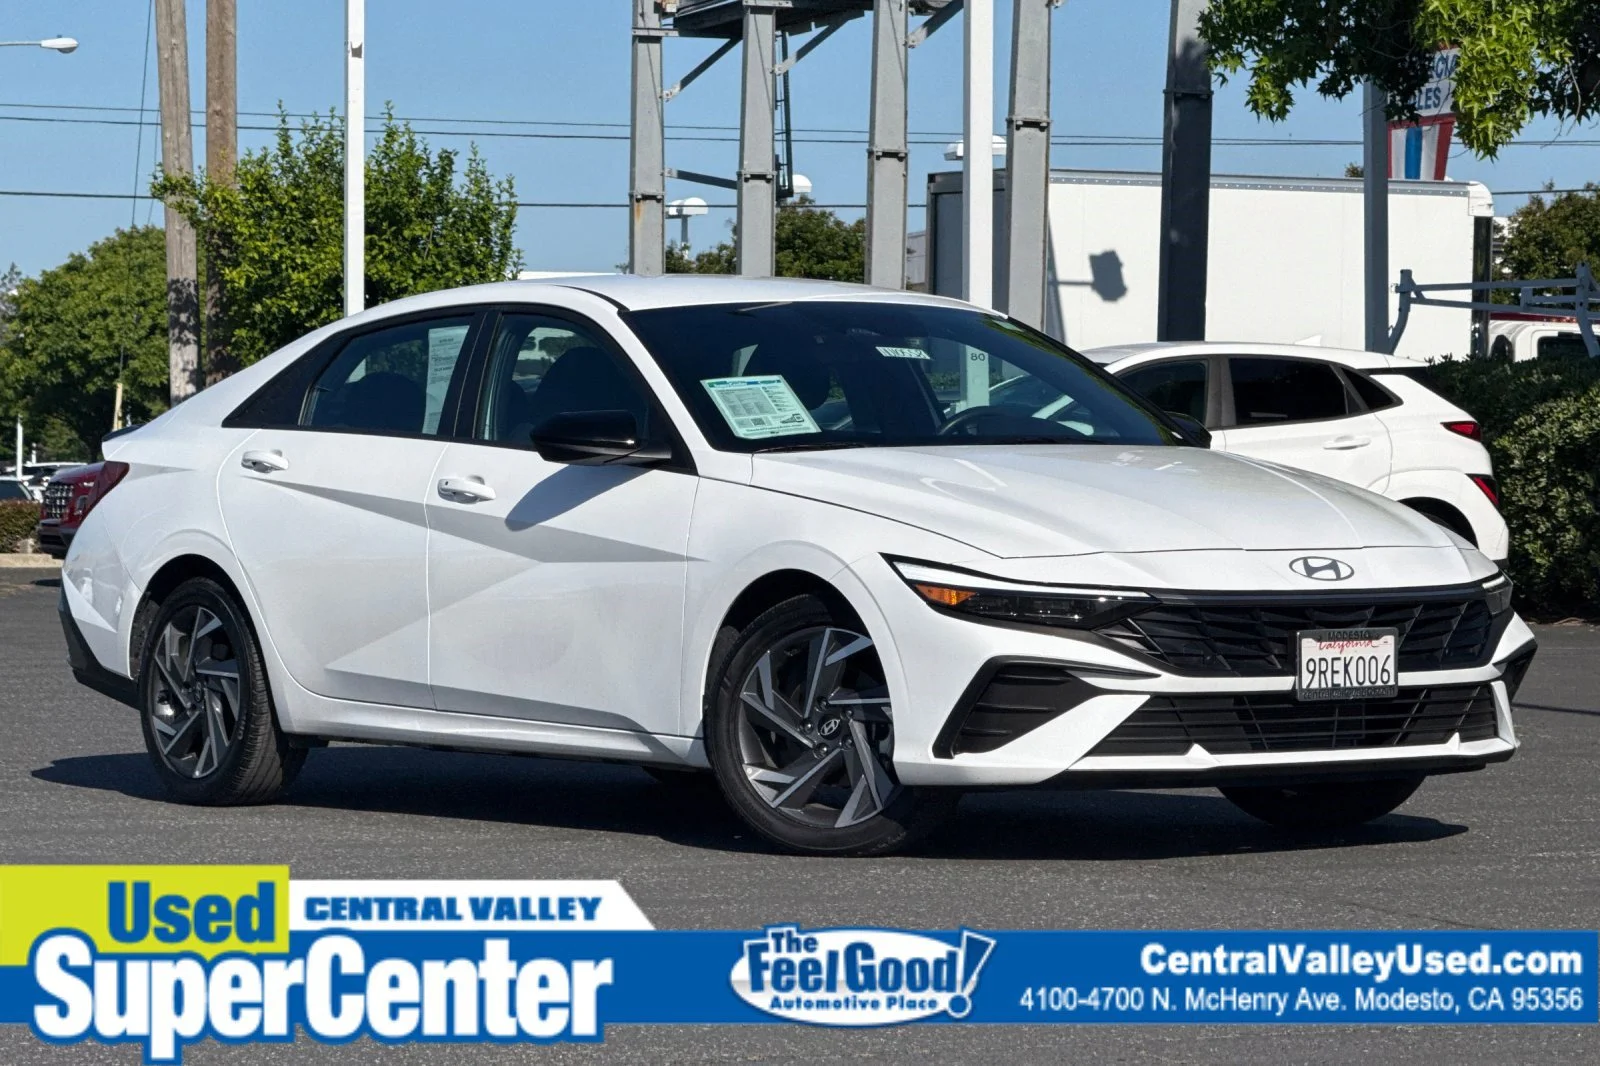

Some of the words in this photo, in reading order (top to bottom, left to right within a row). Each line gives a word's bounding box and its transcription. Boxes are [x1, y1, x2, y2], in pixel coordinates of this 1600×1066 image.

[1415, 86, 1442, 110] LES
[970, 352, 986, 361] 80
[1305, 655, 1391, 688] 9REK006
